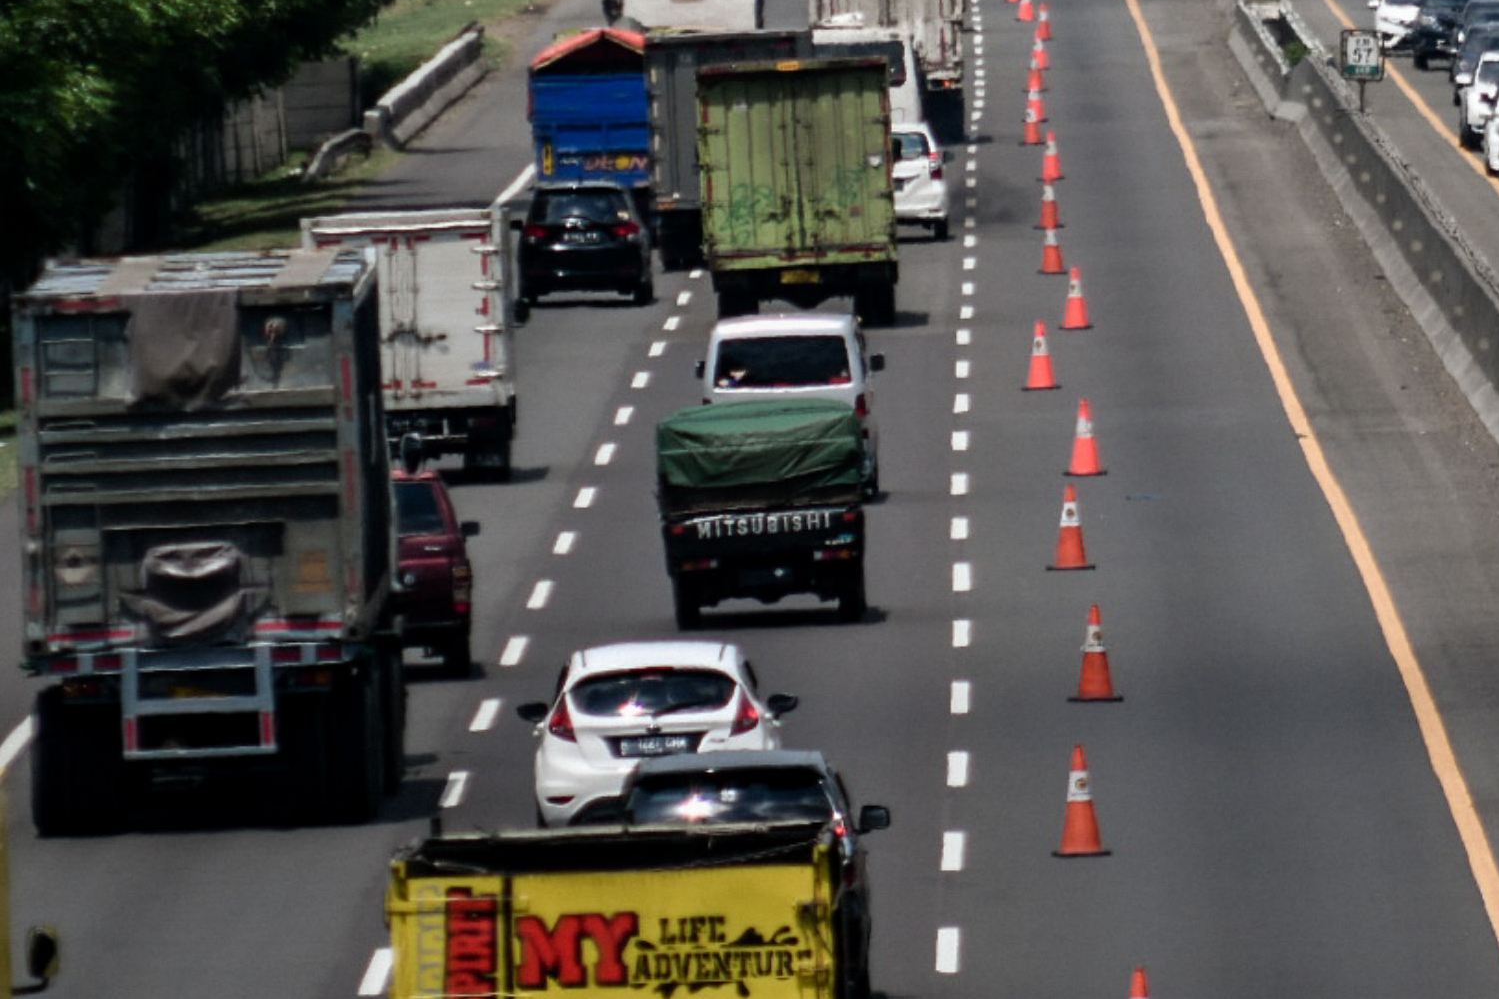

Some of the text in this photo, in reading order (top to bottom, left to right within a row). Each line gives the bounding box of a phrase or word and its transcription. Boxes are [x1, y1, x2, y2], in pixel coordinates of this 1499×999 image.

[1352, 47, 1373, 64] 57
[696, 511, 832, 540] MITSUBISHI
[659, 915, 726, 945] LIFE
[515, 911, 640, 991] MY
